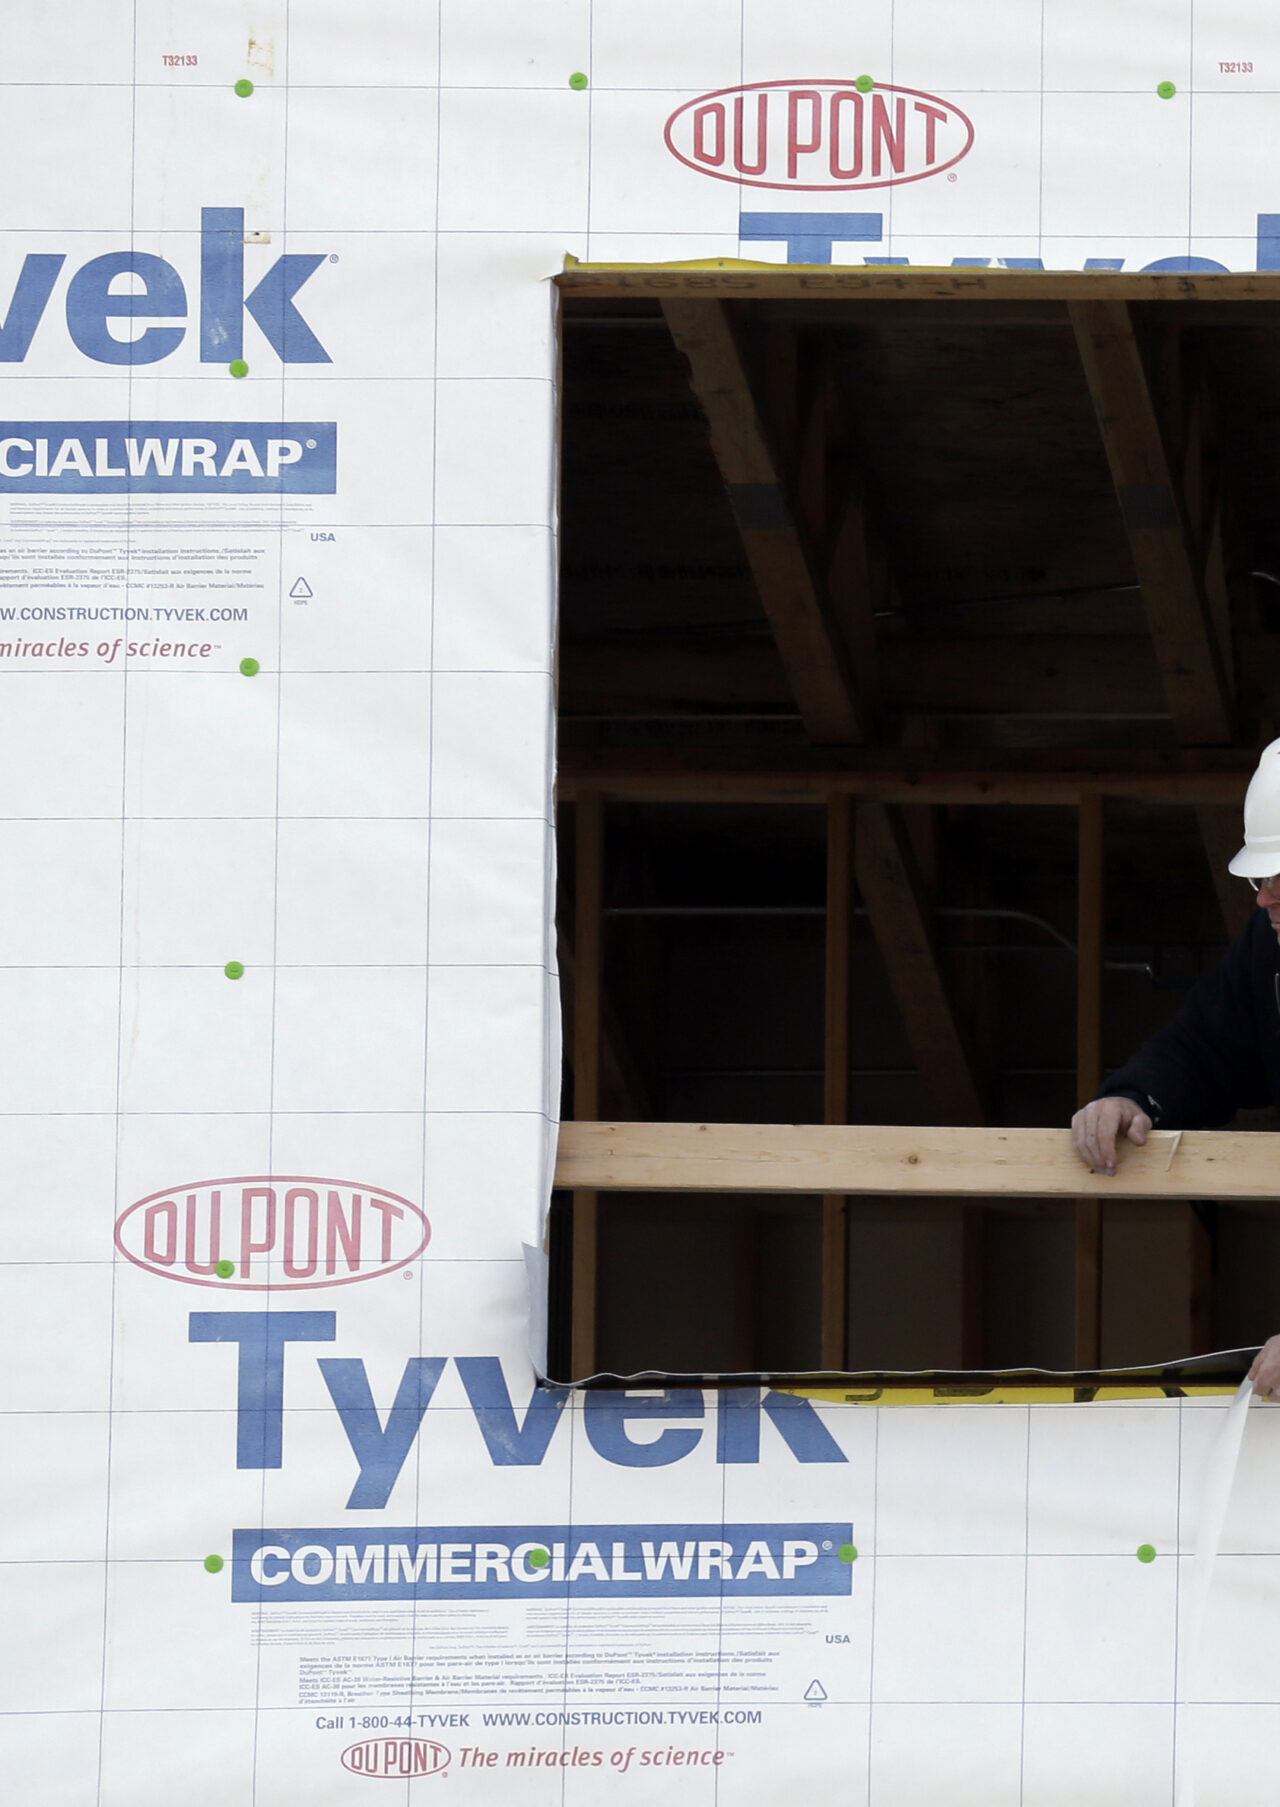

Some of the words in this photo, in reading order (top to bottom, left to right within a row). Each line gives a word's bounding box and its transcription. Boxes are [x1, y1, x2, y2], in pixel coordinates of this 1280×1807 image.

[162, 55, 198, 66] T32133
[1218, 62, 1253, 73] T32133
[310, 533, 336, 542] USA
[97, 638, 123, 663] of
[825, 1634, 851, 1644] USA
[315, 1716, 344, 1729] Call
[349, 1714, 470, 1729] 1-800-44-TYVEK
[482, 1710, 762, 1727] WWW.CONSTRUCTION.TYVEK.COM
[459, 1747, 499, 1767] The
[506, 1746, 603, 1767] miracles
[610, 1747, 637, 1773] of
